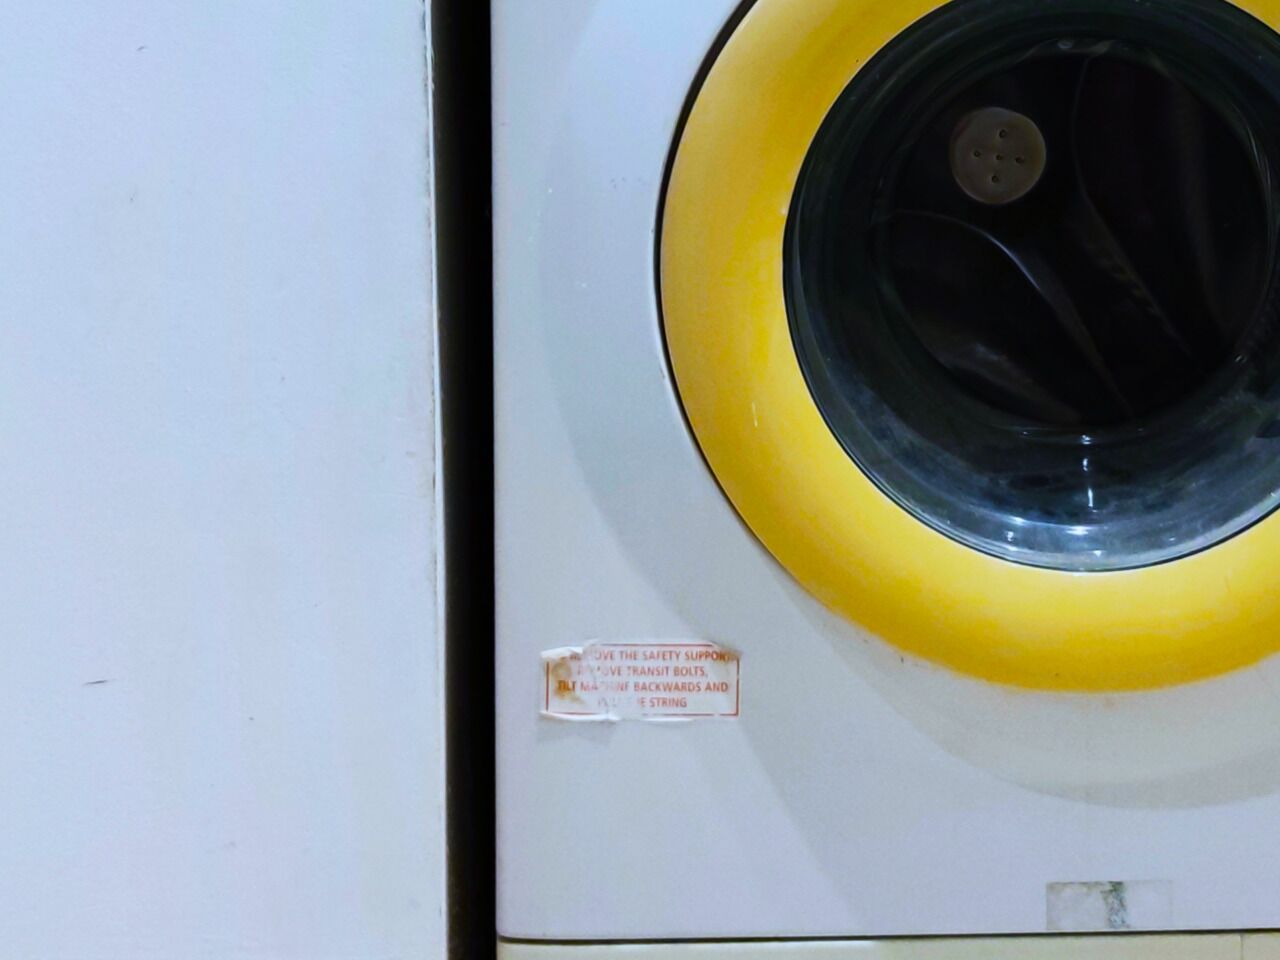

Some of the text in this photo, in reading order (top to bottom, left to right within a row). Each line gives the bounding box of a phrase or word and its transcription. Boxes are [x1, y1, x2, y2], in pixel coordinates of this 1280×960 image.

[620, 651, 637, 660] THE
[643, 650, 681, 661] SAFETY
[627, 666, 670, 677] TRANSIT
[633, 681, 701, 693] BACKWARDS
[704, 681, 729, 693] AND
[649, 697, 688, 708] STRING
